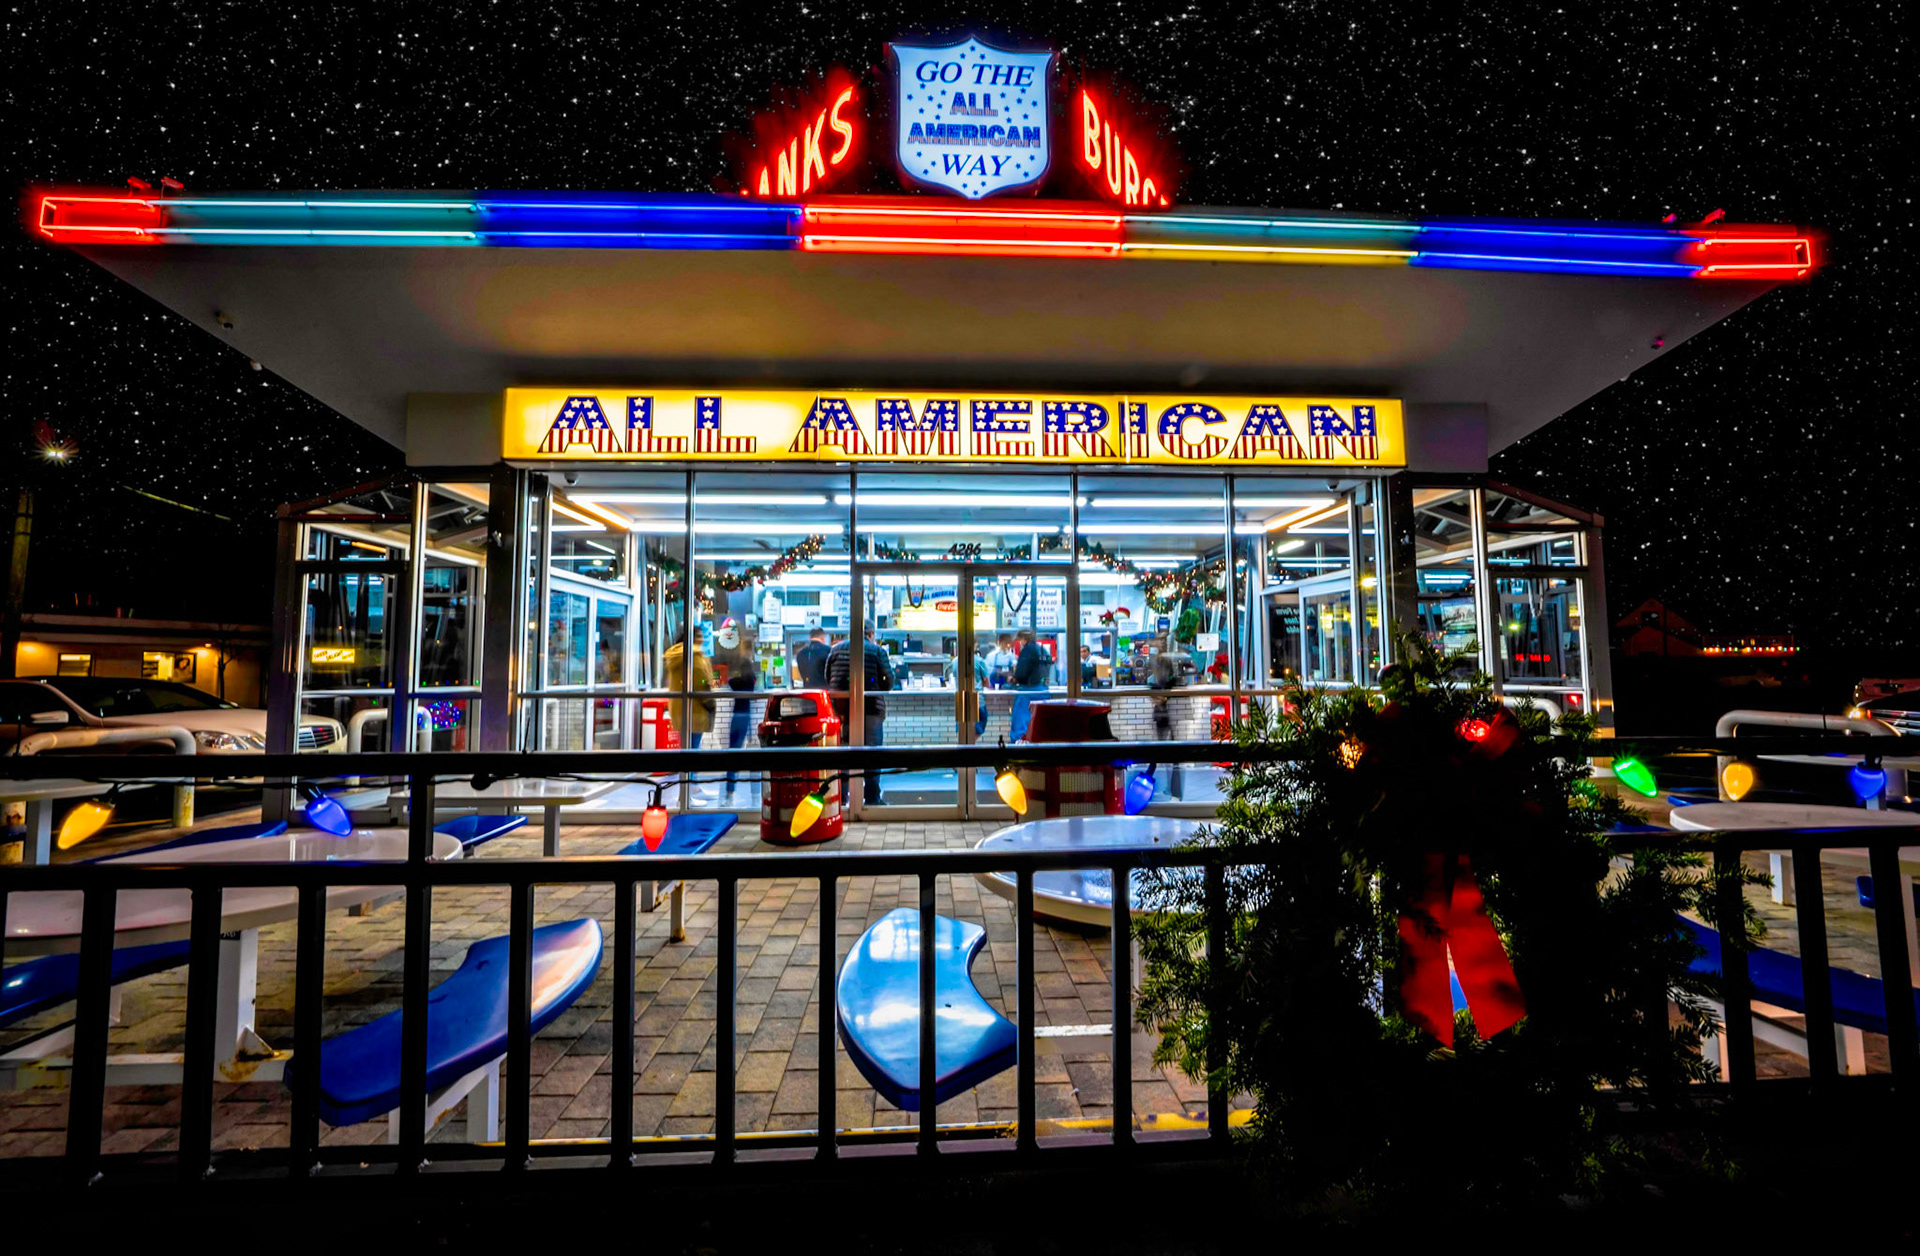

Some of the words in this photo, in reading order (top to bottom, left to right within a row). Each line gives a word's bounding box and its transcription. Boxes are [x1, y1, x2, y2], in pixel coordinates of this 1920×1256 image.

[915, 60, 963, 83] GO
[971, 63, 1035, 87] THE
[950, 92, 998, 117] ALL
[741, 85, 854, 196] ANKS
[907, 122, 1041, 148] AMERICAN
[1083, 89, 1168, 206] BUR
[942, 153, 1012, 177] WAY
[537, 395, 757, 454] ALL
[788, 397, 1379, 461] AMERICAN
[948, 542, 982, 557] 4286
